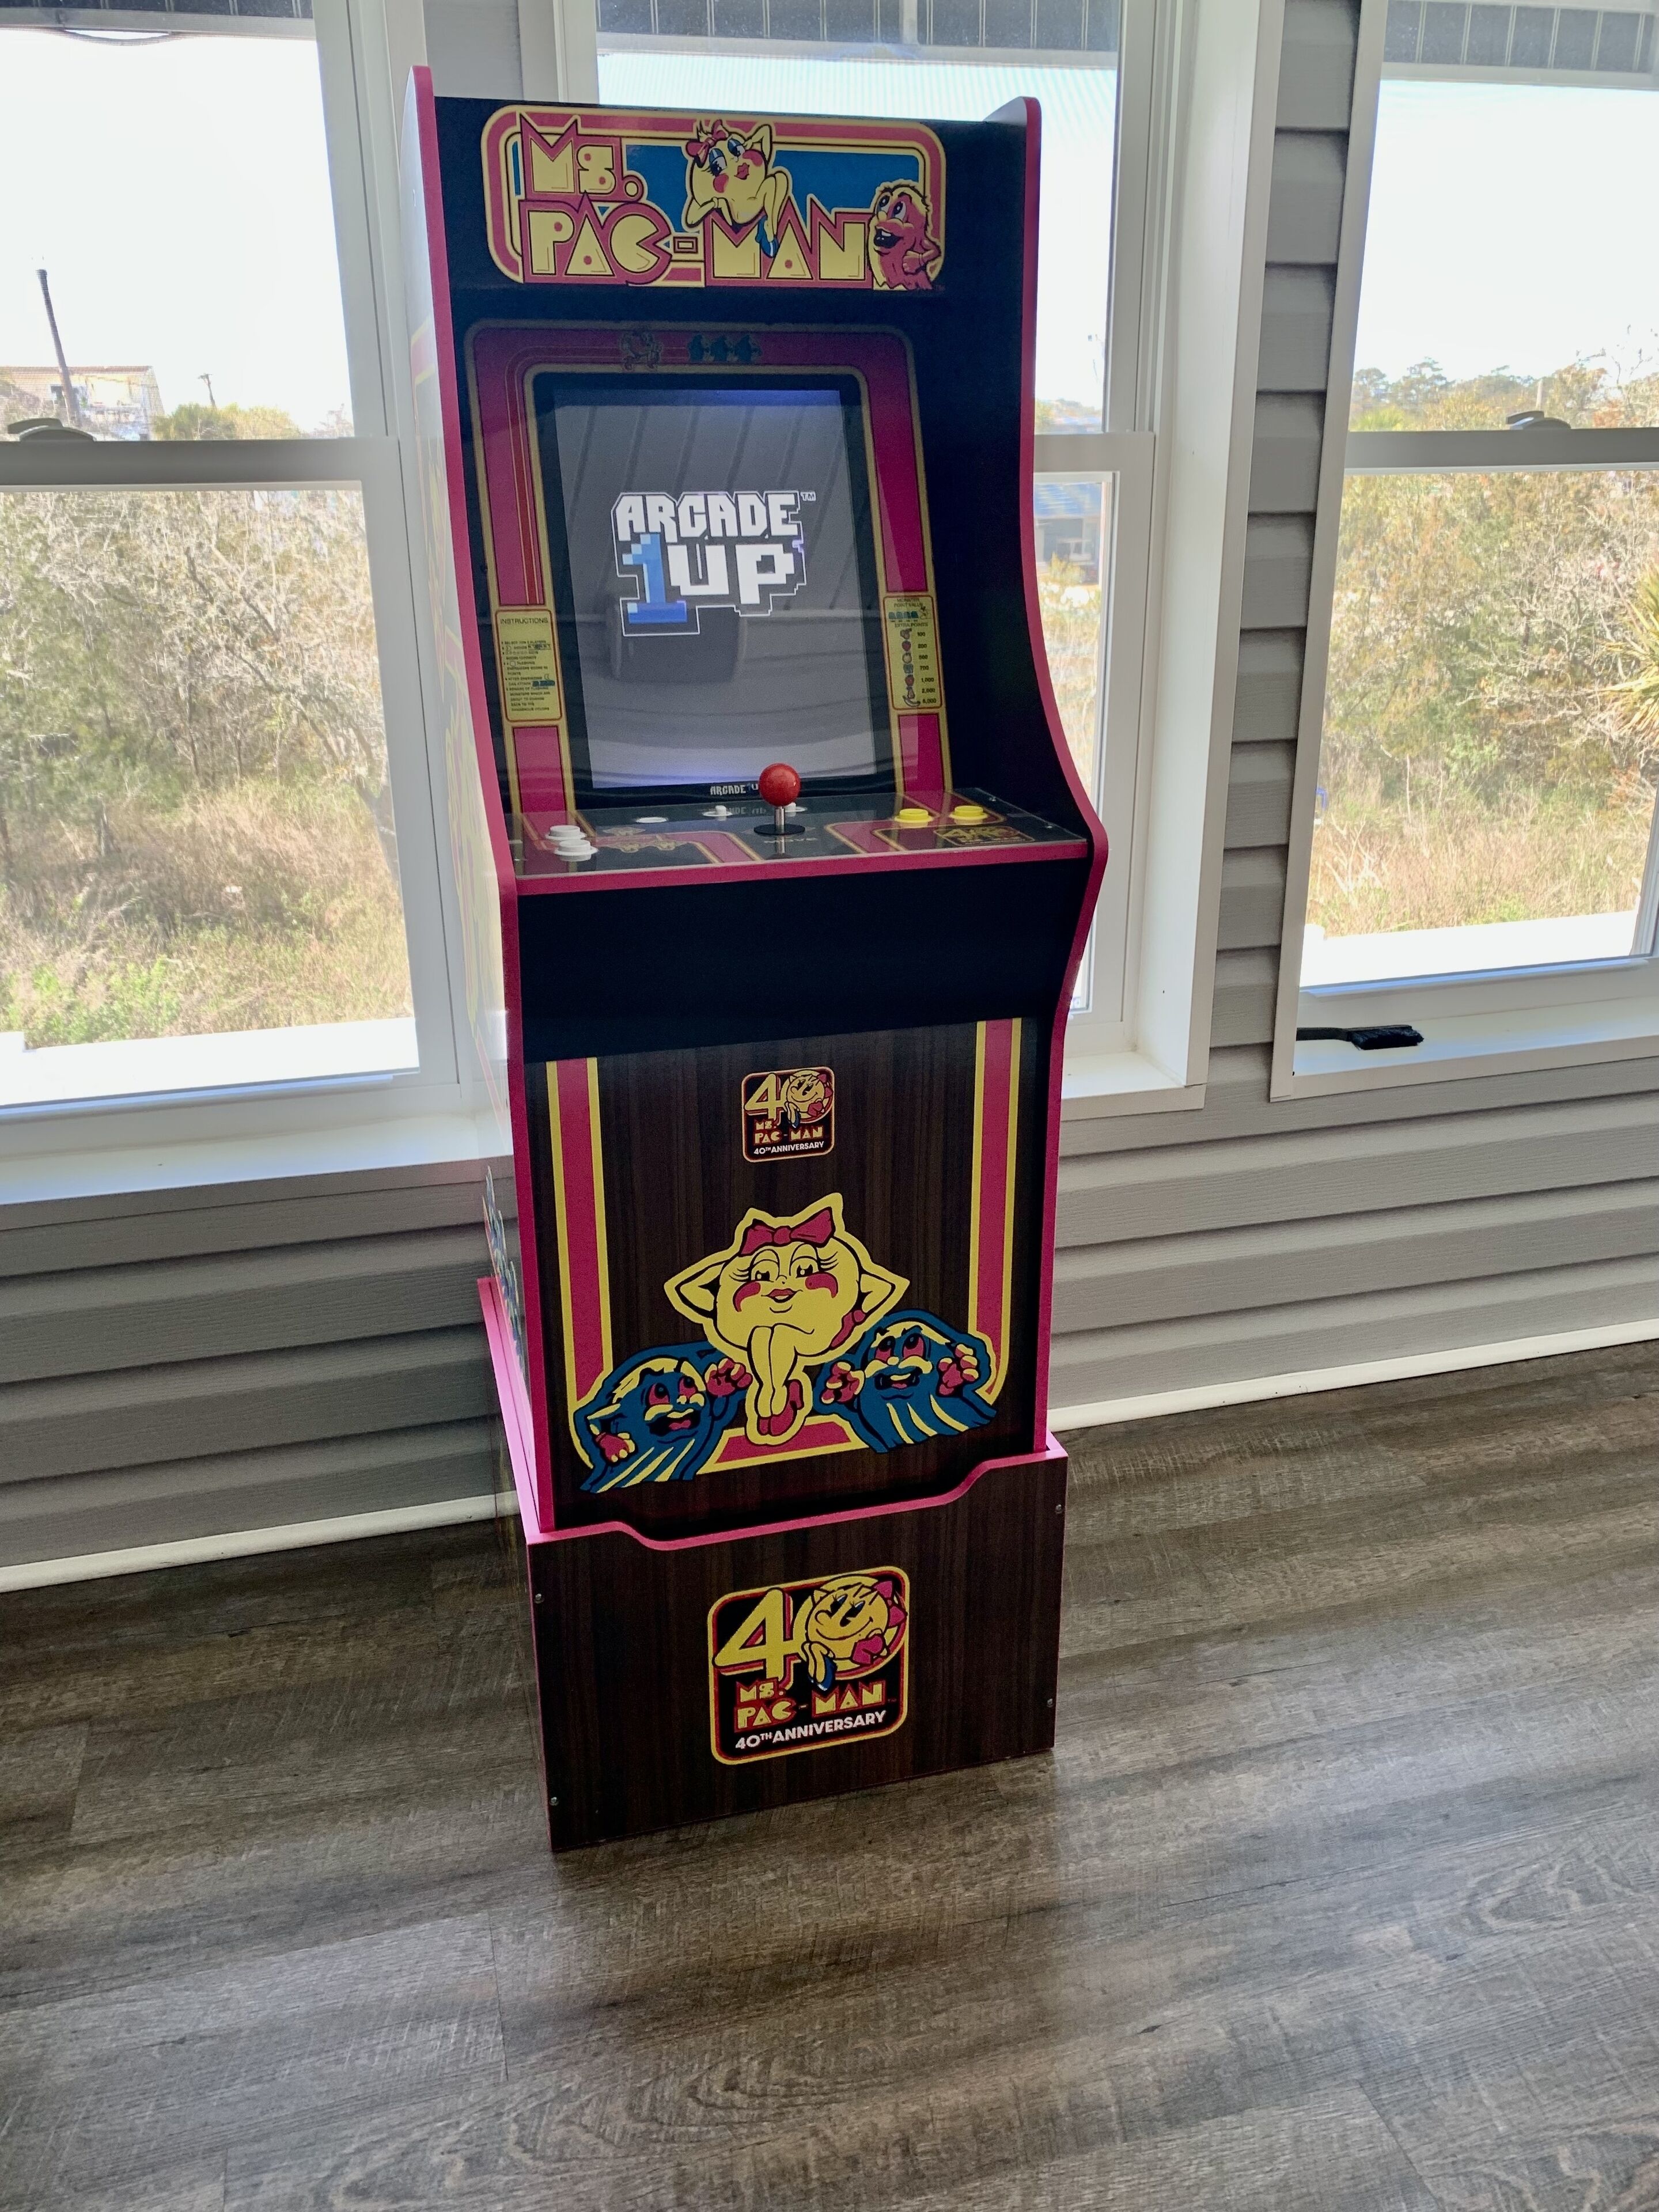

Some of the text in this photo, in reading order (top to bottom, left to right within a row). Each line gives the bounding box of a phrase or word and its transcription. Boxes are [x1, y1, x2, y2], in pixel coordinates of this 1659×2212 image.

[523, 199, 871, 287] PAC-MAN
[616, 493, 798, 543] ARCADE
[710, 785, 747, 796] ARCADE
[755, 1126, 824, 1144] PAC-MAN
[771, 1141, 824, 1153] ANNIVERSARY
[735, 1679, 885, 1732] PAC-MAN
[772, 1710, 887, 1744] ANNIVERSARY
